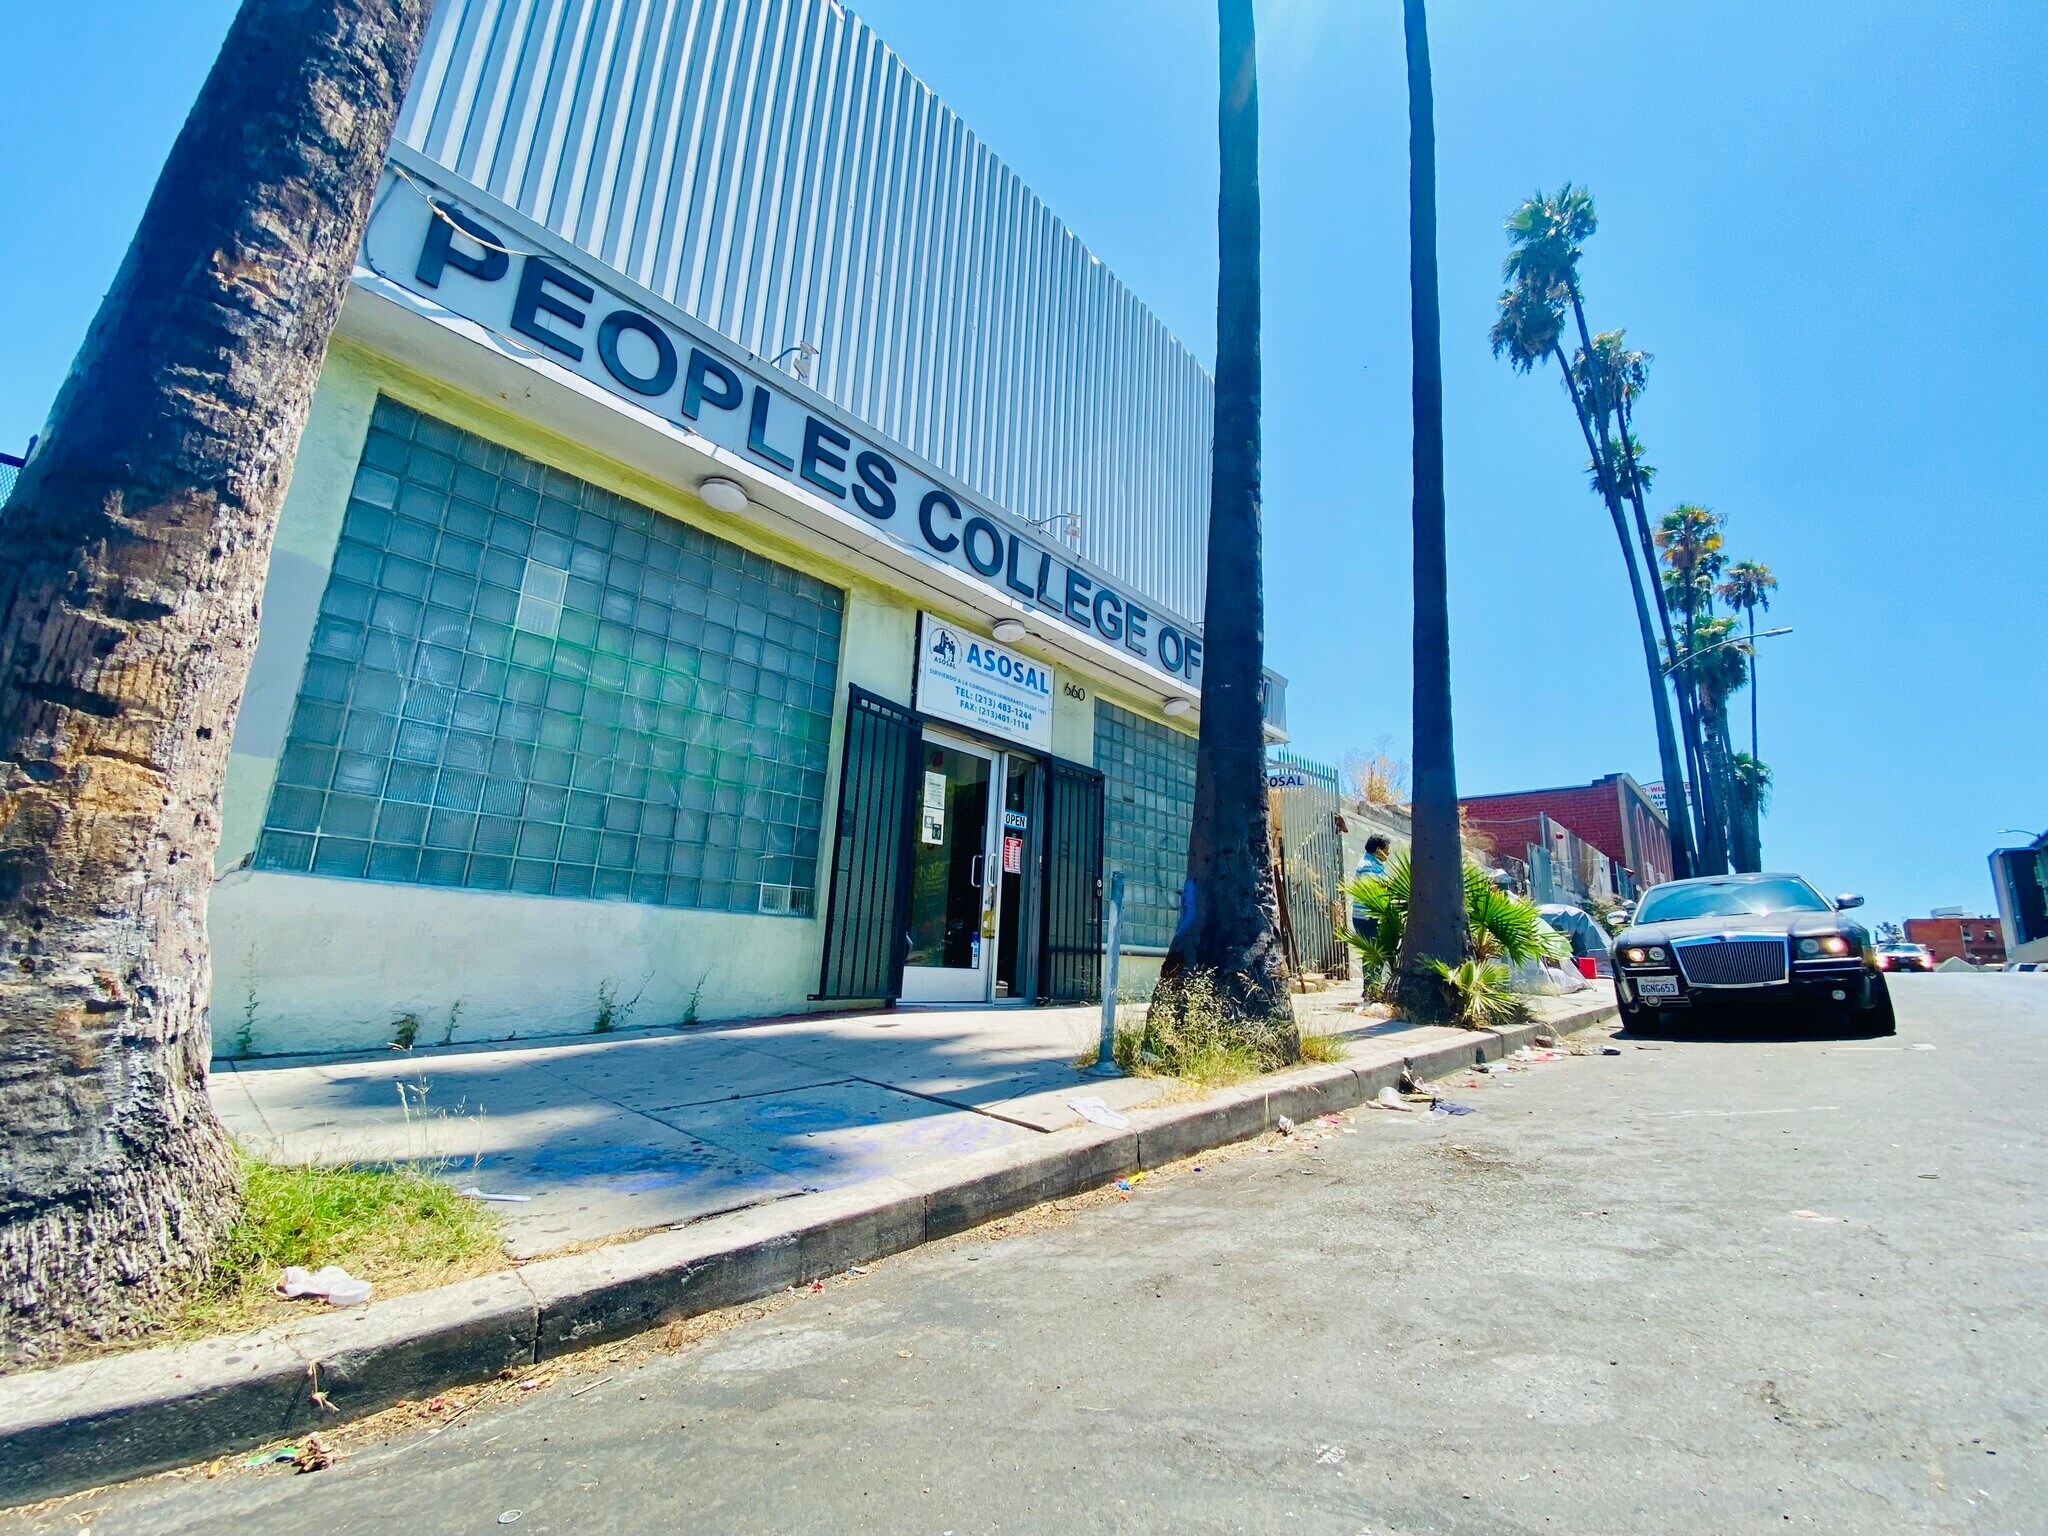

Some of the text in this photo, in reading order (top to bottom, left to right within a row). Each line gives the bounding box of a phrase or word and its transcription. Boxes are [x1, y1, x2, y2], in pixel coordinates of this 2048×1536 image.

[415, 200, 1202, 680] PEOPLES COLLEGE OF
[934, 655, 956, 669] ASOSAL
[967, 643, 1049, 694] ASOSAL
[929, 667, 956, 682] SIRVIENDO
[969, 682, 997, 697] COMUNIDAD
[1064, 682, 1085, 702] 660
[954, 685, 1032, 721] TEL: (213) 483-1244
[959, 699, 1029, 730] FAX: (213)401-1118
[1270, 776, 1304, 787] OSAL
[1005, 813, 1025, 827] OPEN
[1641, 984, 1676, 993] 8GNG653
